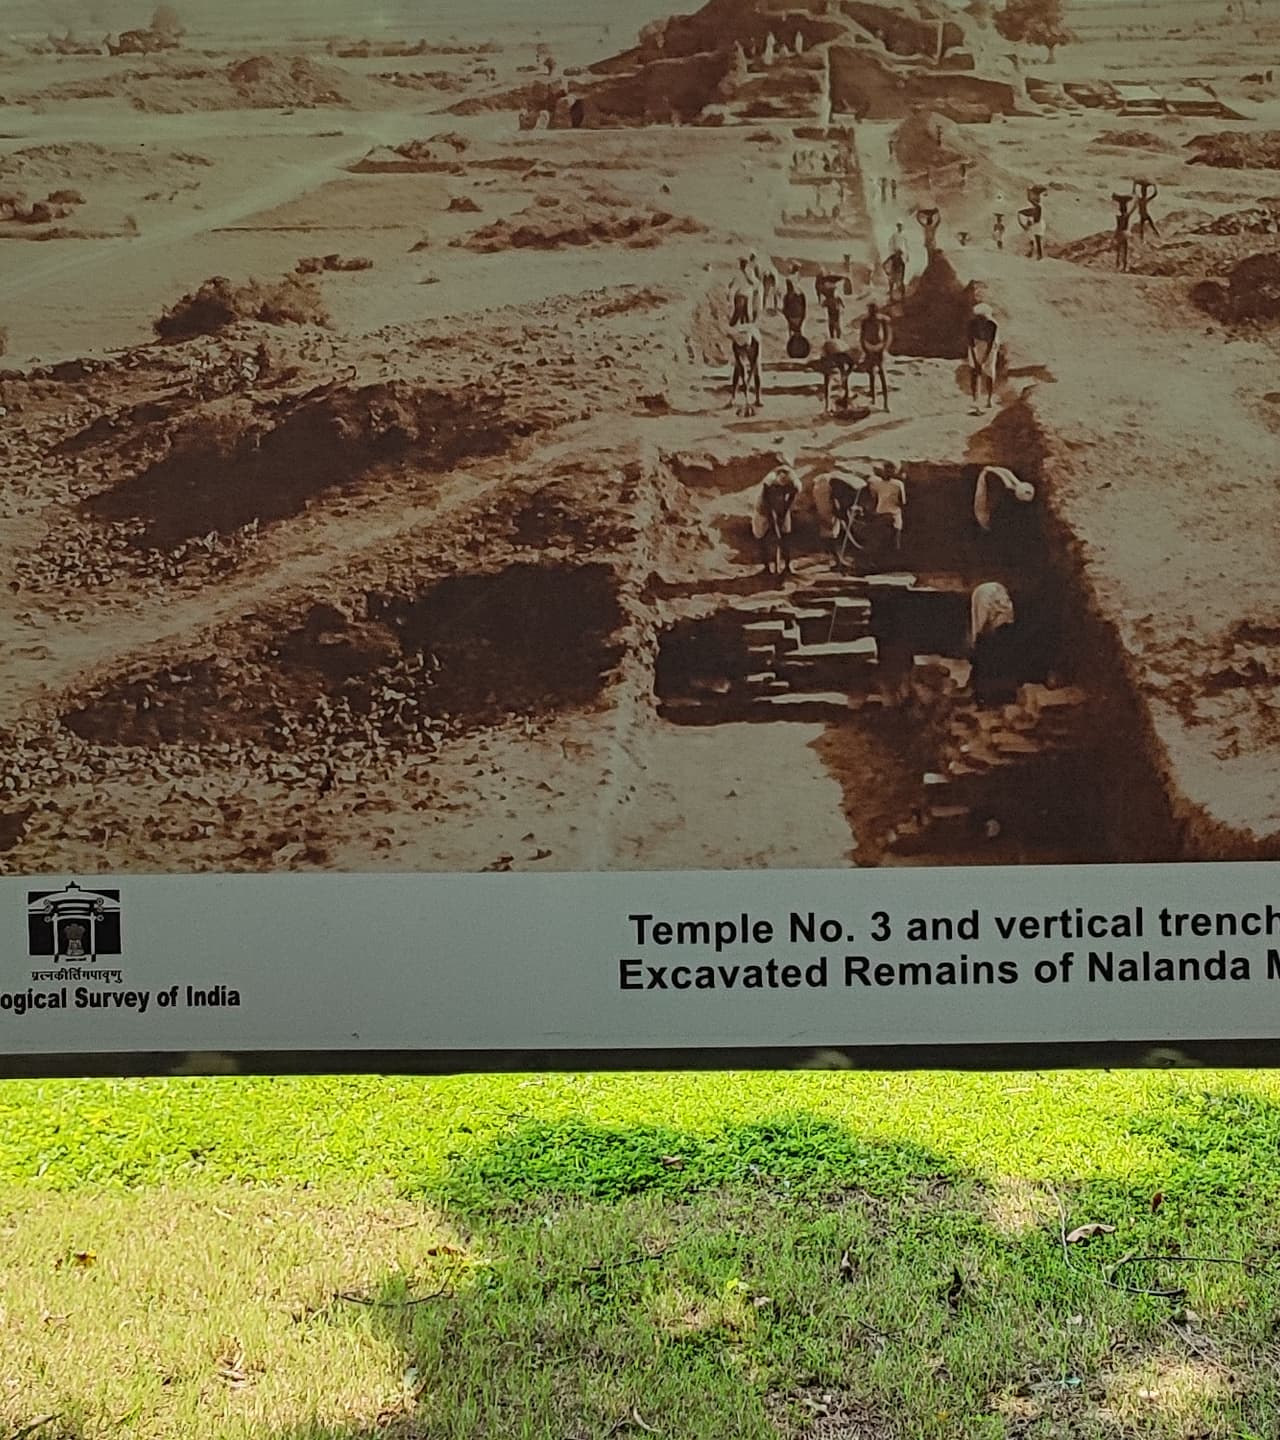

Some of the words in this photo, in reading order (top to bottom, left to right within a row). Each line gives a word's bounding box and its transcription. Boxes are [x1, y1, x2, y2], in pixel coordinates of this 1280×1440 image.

[628, 913, 775, 953] Temple
[789, 911, 855, 943] No.
[870, 910, 893, 942] 3
[906, 909, 980, 942] and
[994, 906, 1144, 940] vertical
[619, 956, 829, 990] Excavated
[844, 955, 1020, 987] Remains
[1033, 951, 1075, 984] of
[1088, 949, 1252, 983] Nalanda
[73, 985, 151, 1014] Survey
[155, 985, 180, 1009] of
[185, 984, 242, 1008] India
